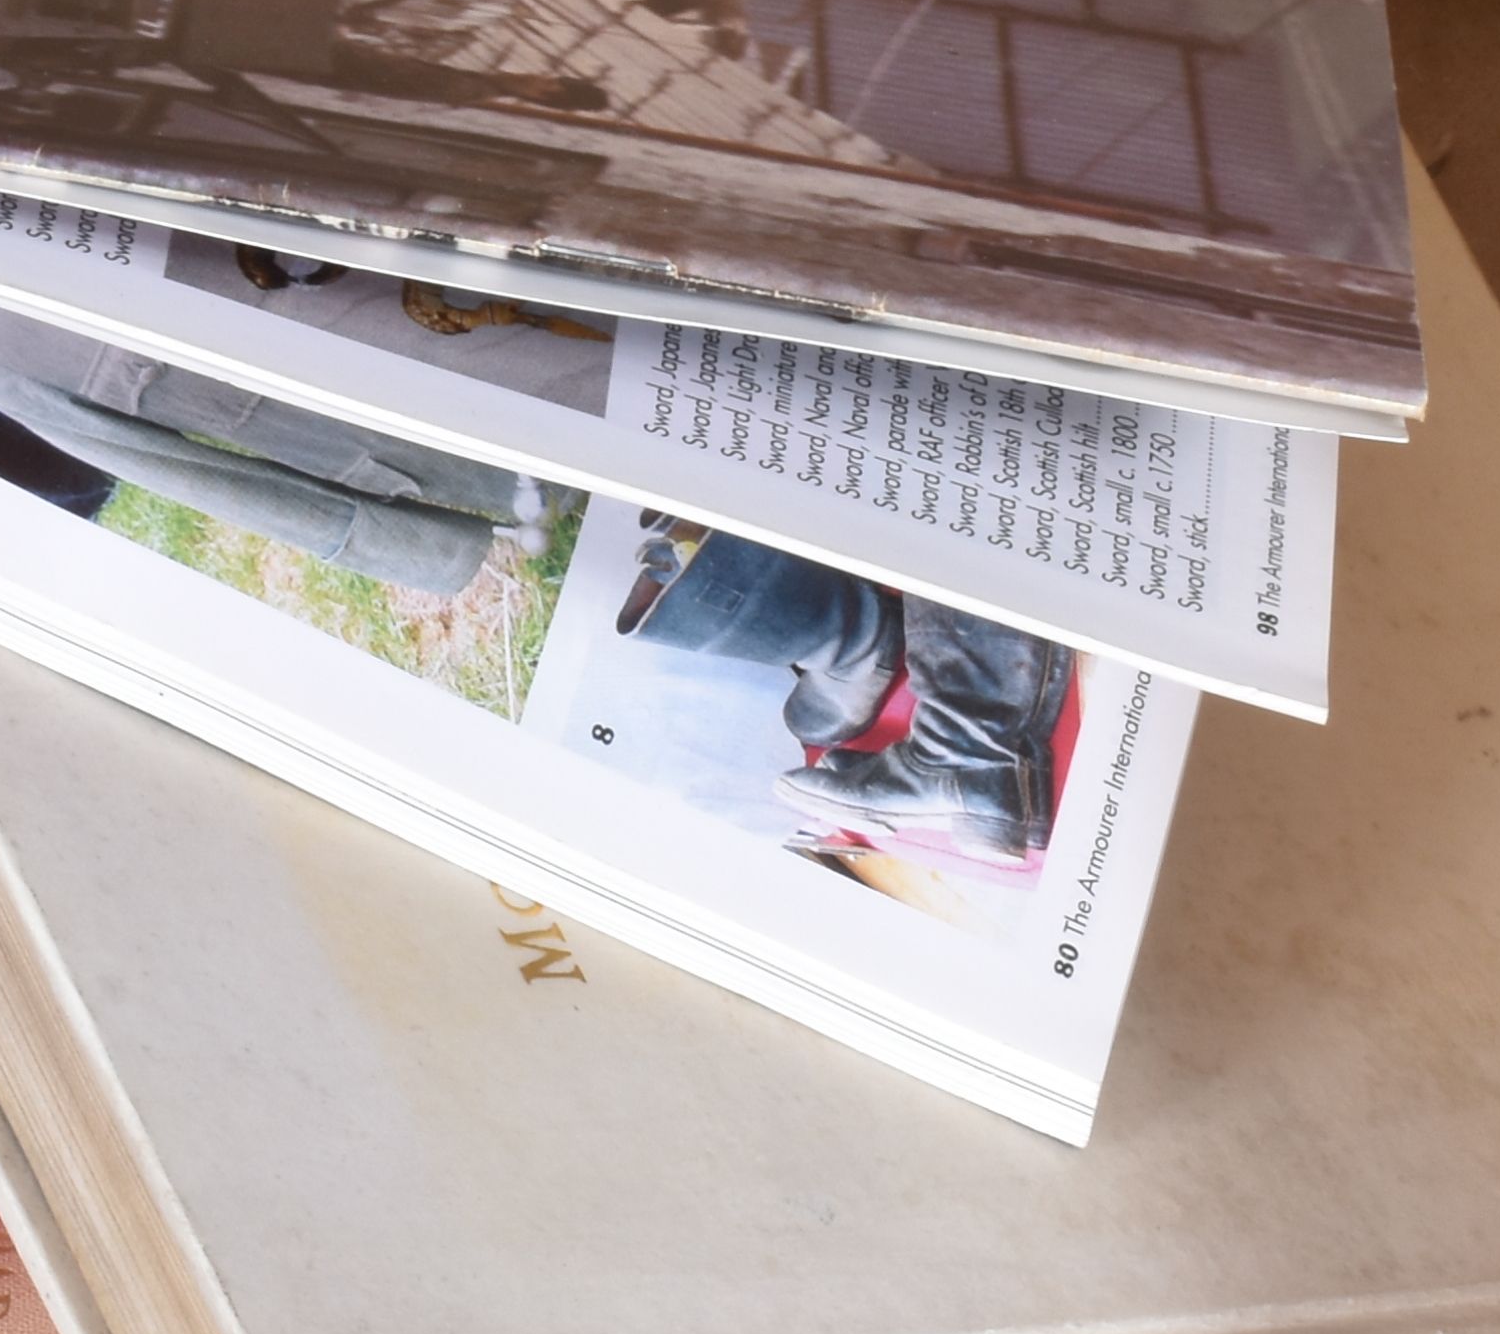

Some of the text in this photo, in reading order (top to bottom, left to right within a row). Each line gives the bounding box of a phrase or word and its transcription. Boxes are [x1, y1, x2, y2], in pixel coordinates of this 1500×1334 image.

[644, 381, 679, 438] Sword,
[727, 360, 762, 404] Light
[759, 341, 799, 474] Sword, miniature
[805, 373, 832, 429] Naval
[958, 382, 988, 409] of
[682, 394, 717, 450] Sword,
[720, 407, 756, 462] Sword,
[842, 386, 871, 441] Naval
[880, 394, 911, 456] parade
[797, 431, 832, 487] Sword,
[836, 444, 871, 500] Sword,
[912, 374, 951, 525] Sword, RAF officer
[954, 410, 986, 478] Robbin's
[987, 385, 1026, 550] Sword, Scottish 18th
[1031, 440, 1061, 502] Scottish
[873, 456, 909, 512] Sword,
[950, 480, 985, 538] Sword,
[1068, 454, 1099, 514] Scottish
[1105, 479, 1134, 527] small
[1026, 505, 1060, 563] Sword,
[1143, 491, 1172, 539] small
[1063, 518, 1098, 575] Sword,
[1101, 529, 1136, 588] Sword,
[1140, 542, 1175, 600] Sword,
[1261, 510, 1286, 579] Armourer
[1178, 554, 1212, 613] Sword,
[1259, 580, 1282, 608] The
[1256, 611, 1279, 637] 98
[591, 723, 615, 746] 8
[1077, 794, 1120, 898] Armourer
[1063, 898, 1093, 937] The
[1053, 942, 1081, 980] 80
